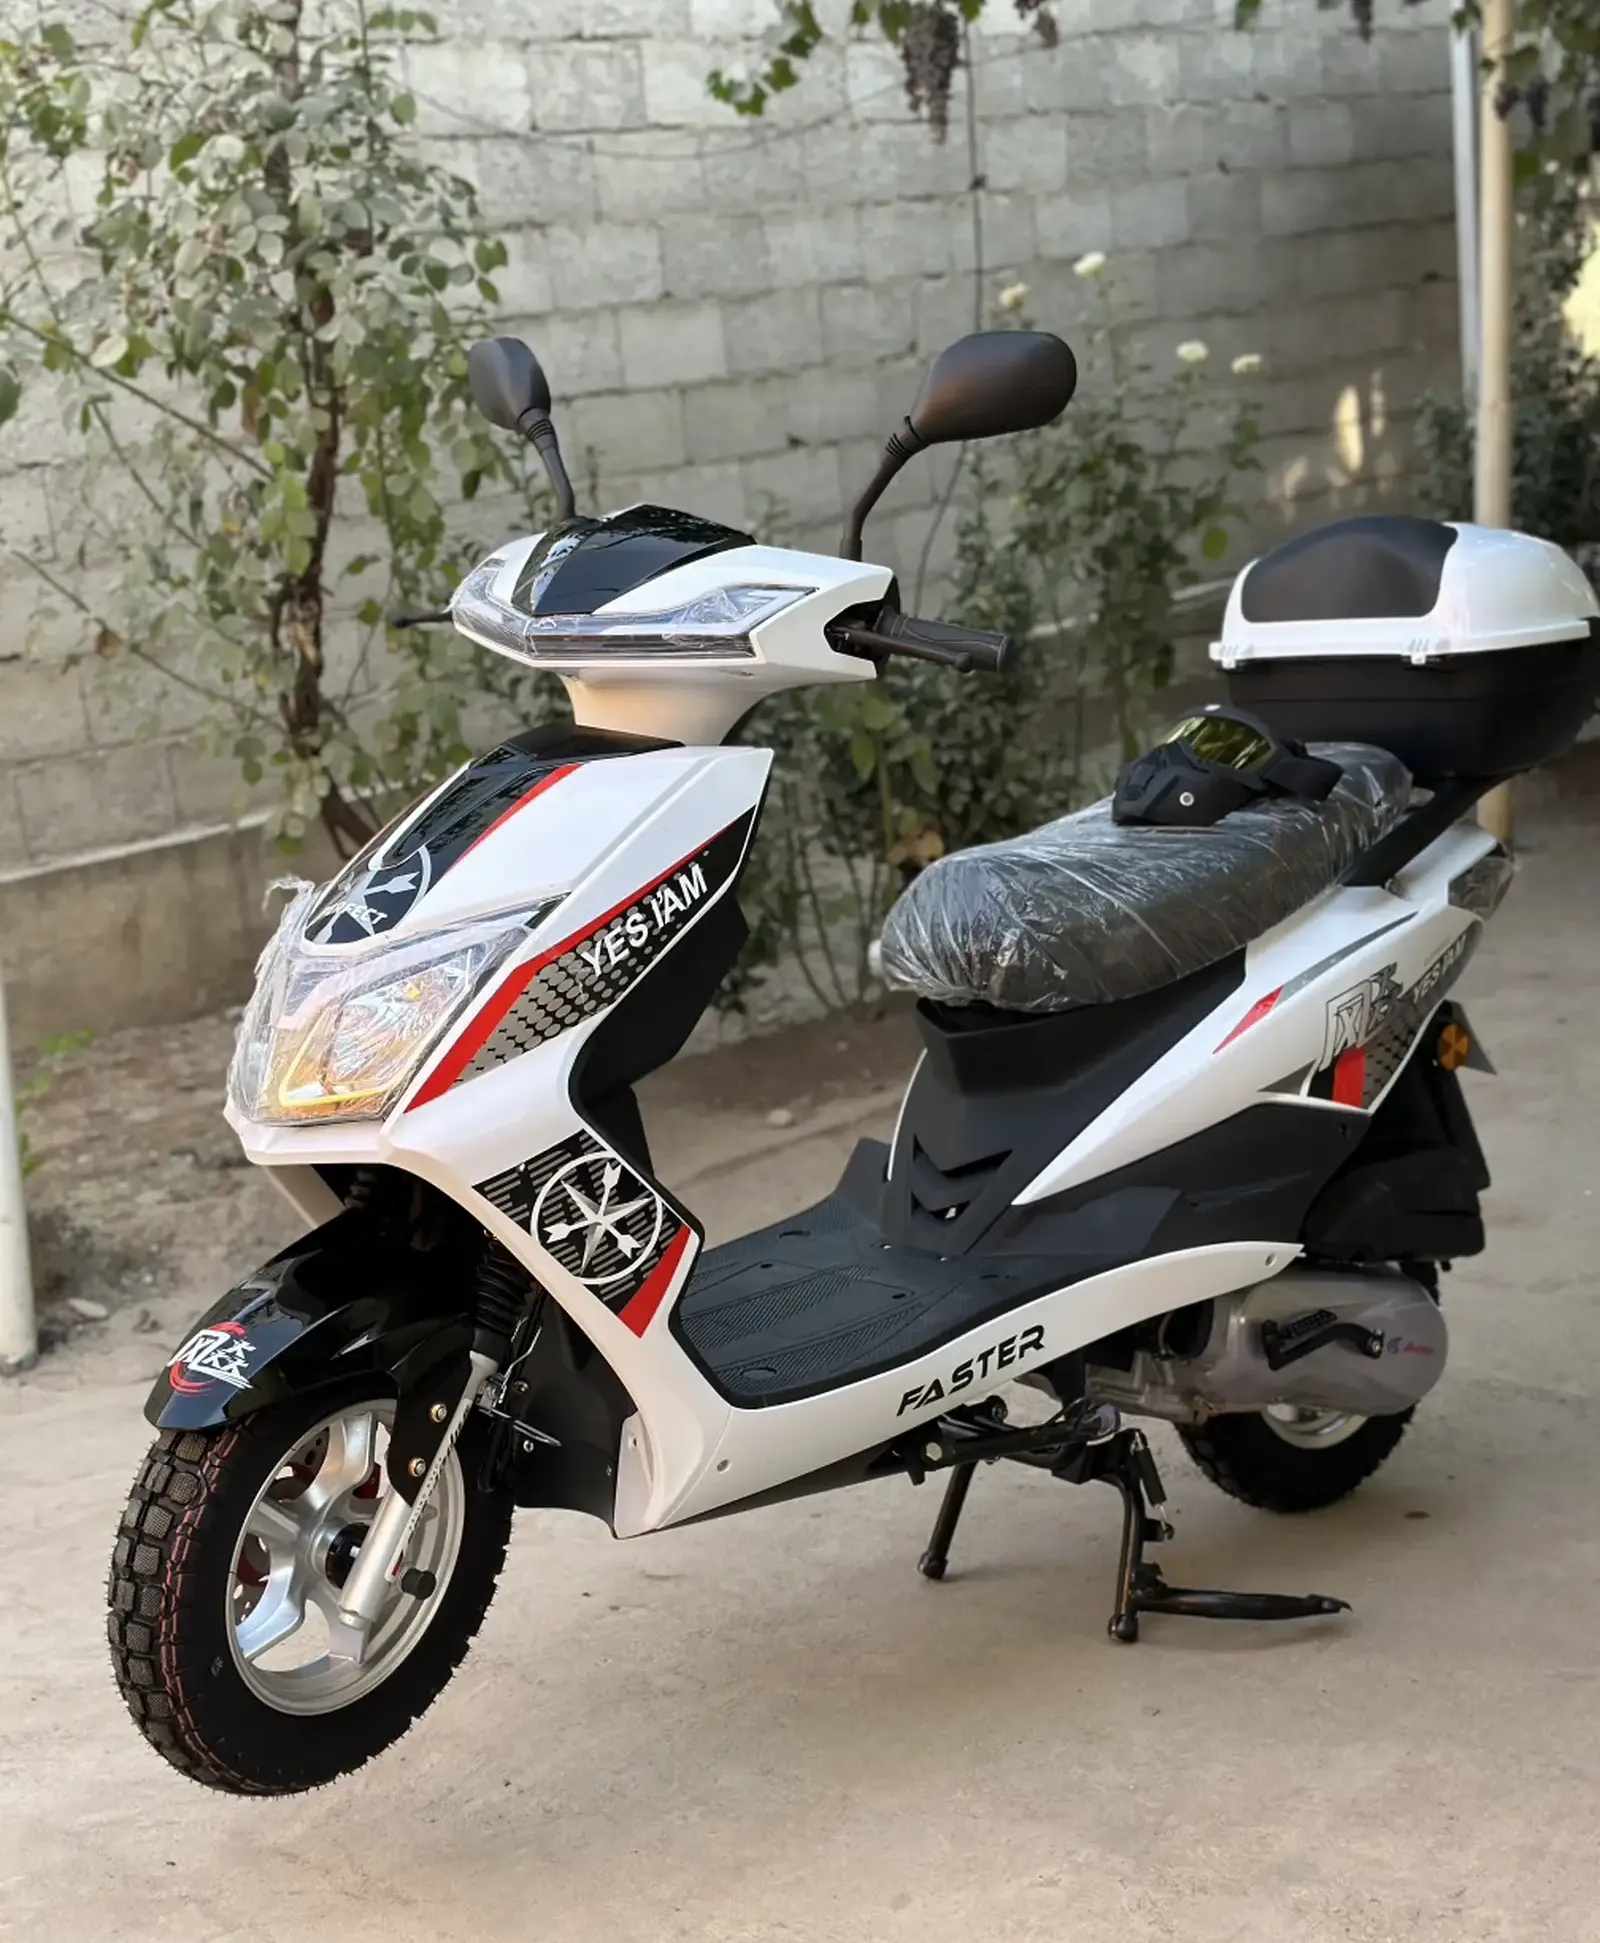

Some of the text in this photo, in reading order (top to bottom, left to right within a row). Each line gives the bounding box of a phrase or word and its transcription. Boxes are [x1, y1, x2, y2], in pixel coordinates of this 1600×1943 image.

[580, 863, 708, 977] YES I'AM
[896, 1324, 1045, 1417] FASTER
